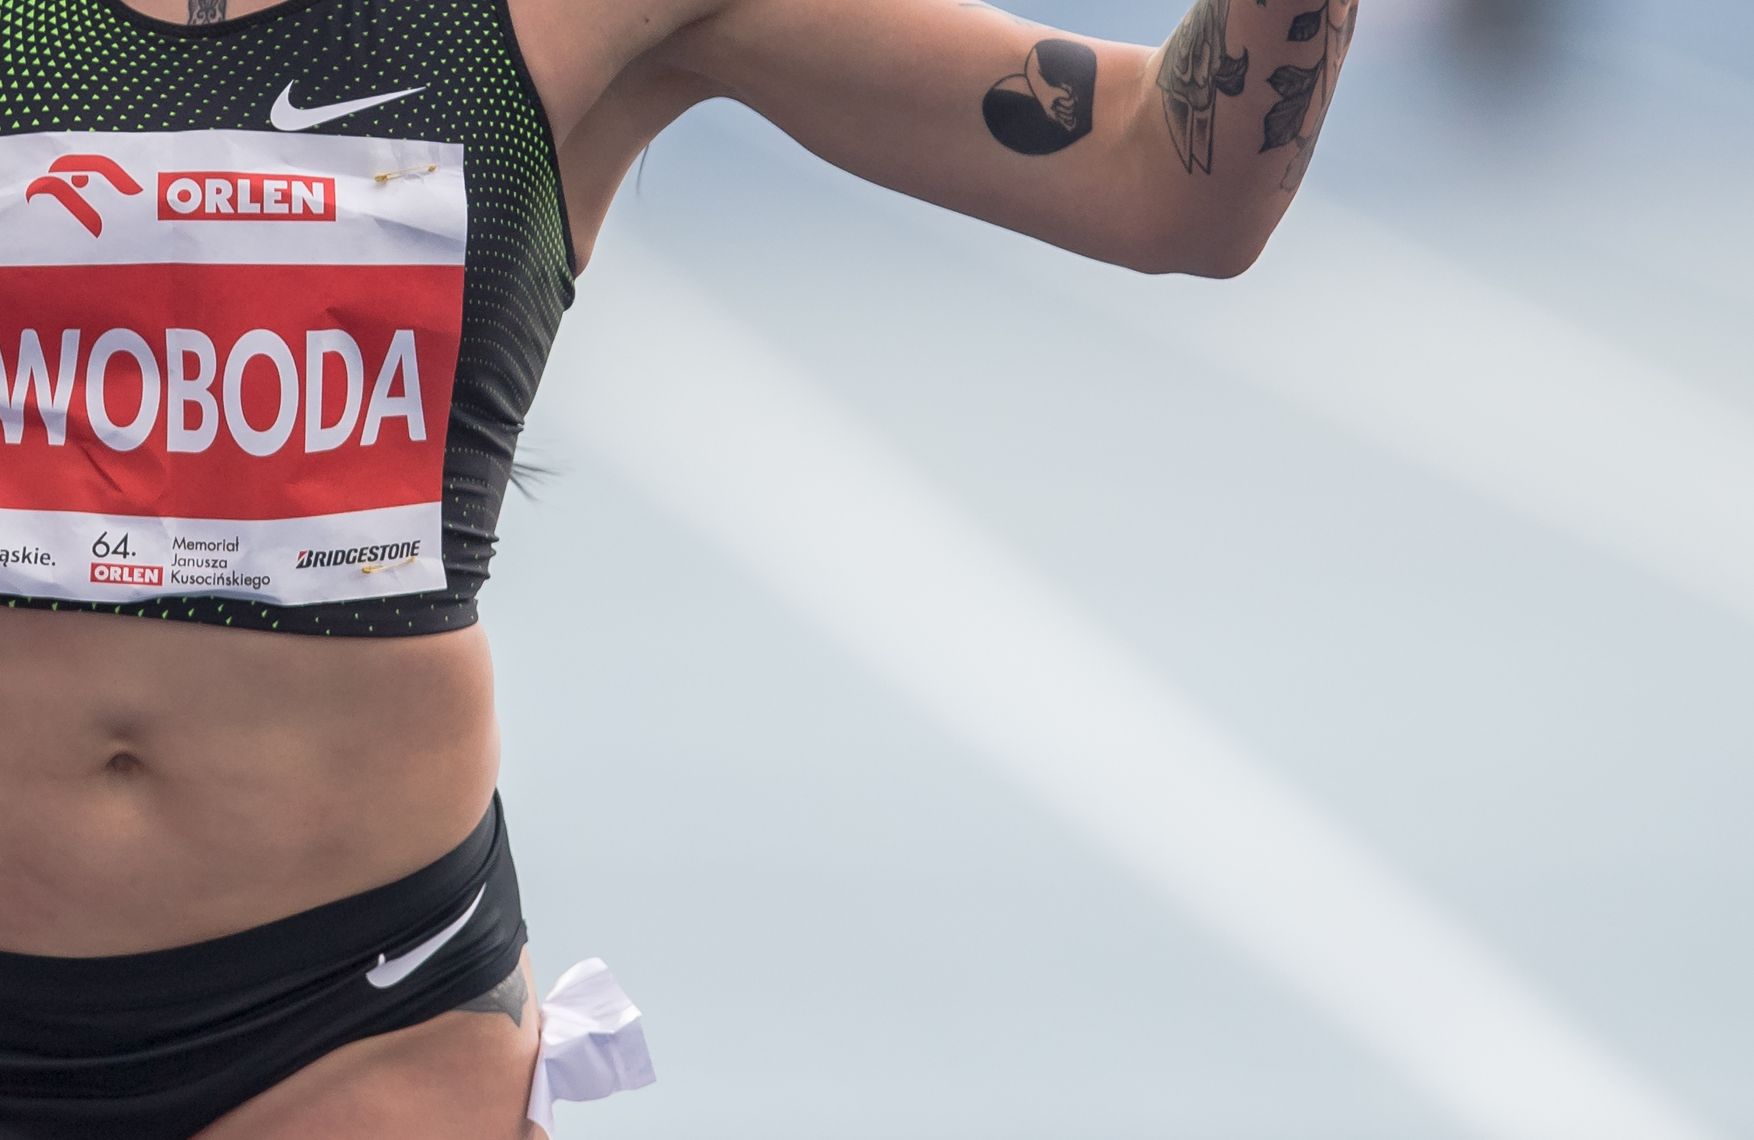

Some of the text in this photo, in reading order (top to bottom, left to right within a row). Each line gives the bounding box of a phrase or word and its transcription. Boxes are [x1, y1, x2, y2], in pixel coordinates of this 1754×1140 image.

[165, 177, 327, 215] ORLEN
[91, 530, 137, 560] 64.
[172, 536, 240, 553] Memoriał
[295, 539, 421, 570] BRIDGESTONE
[170, 553, 228, 569] Janusza
[93, 564, 160, 584] ORLEN
[170, 570, 271, 590] Kusocińskiego
